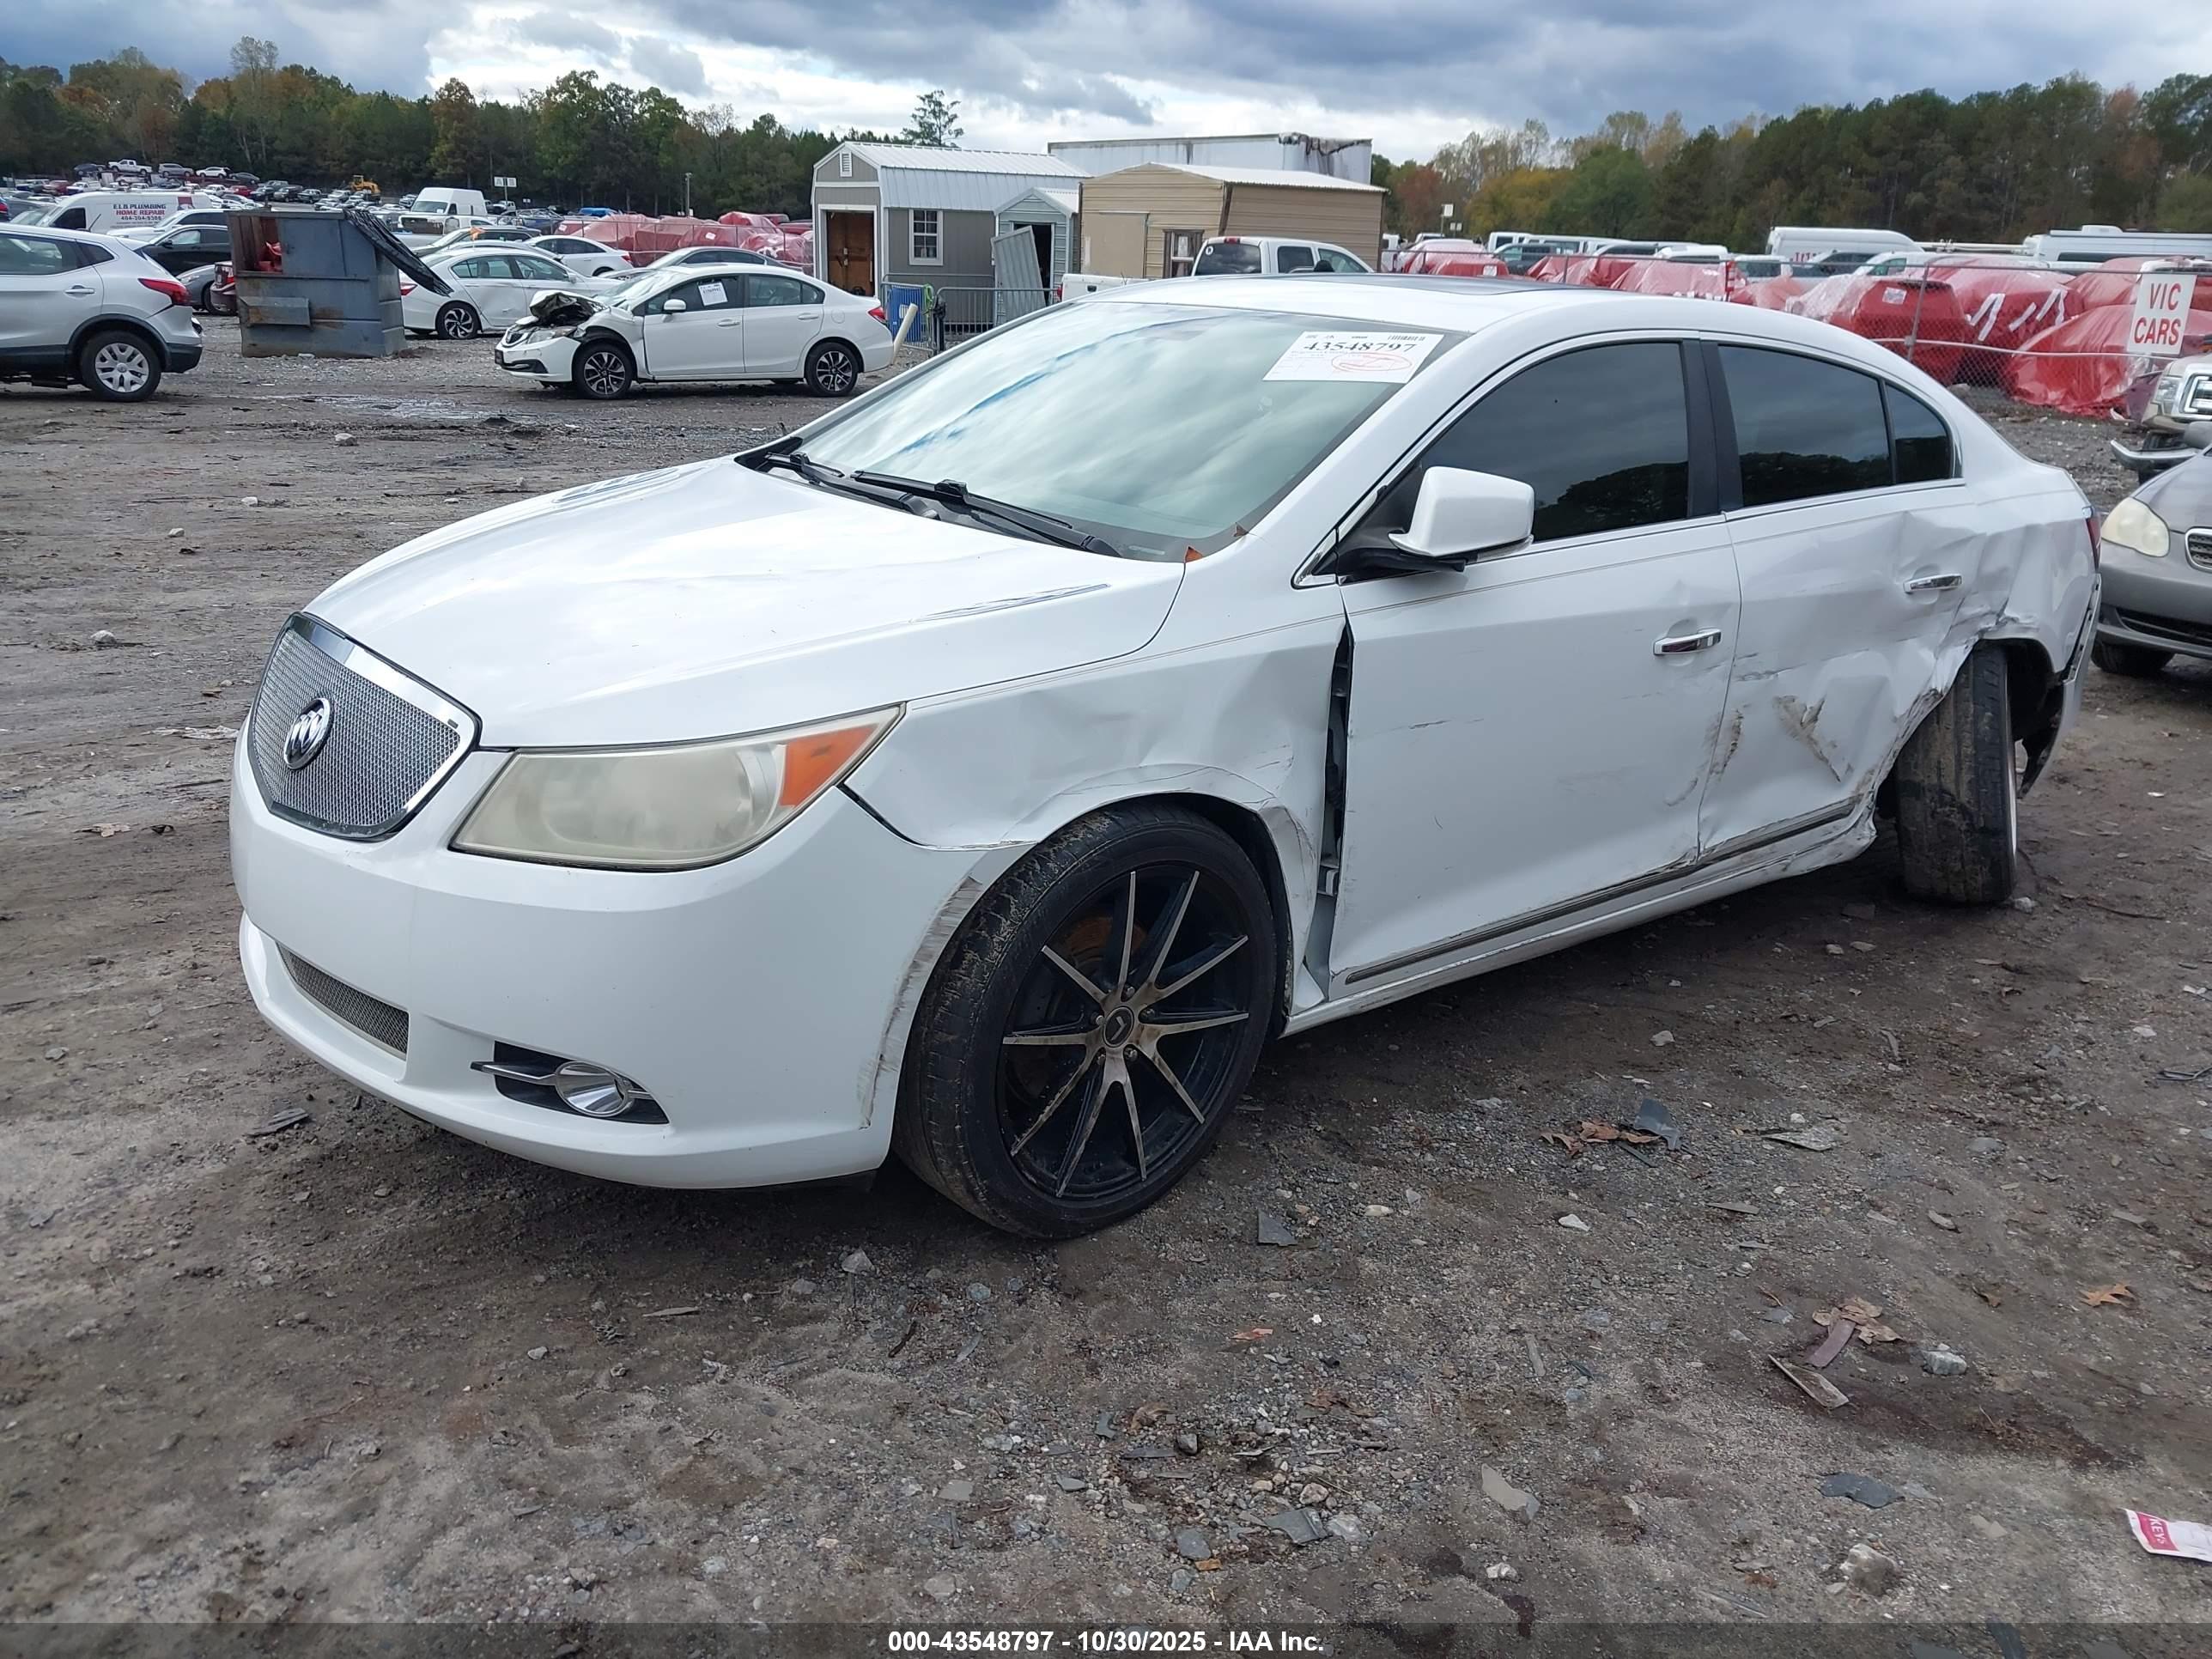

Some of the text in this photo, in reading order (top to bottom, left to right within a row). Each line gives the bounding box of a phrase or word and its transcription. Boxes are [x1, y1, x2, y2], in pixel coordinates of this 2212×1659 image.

[2149, 283, 2181, 311] VIC
[2134, 317, 2181, 346] CARS
[1304, 342, 1417, 352] 43548797
